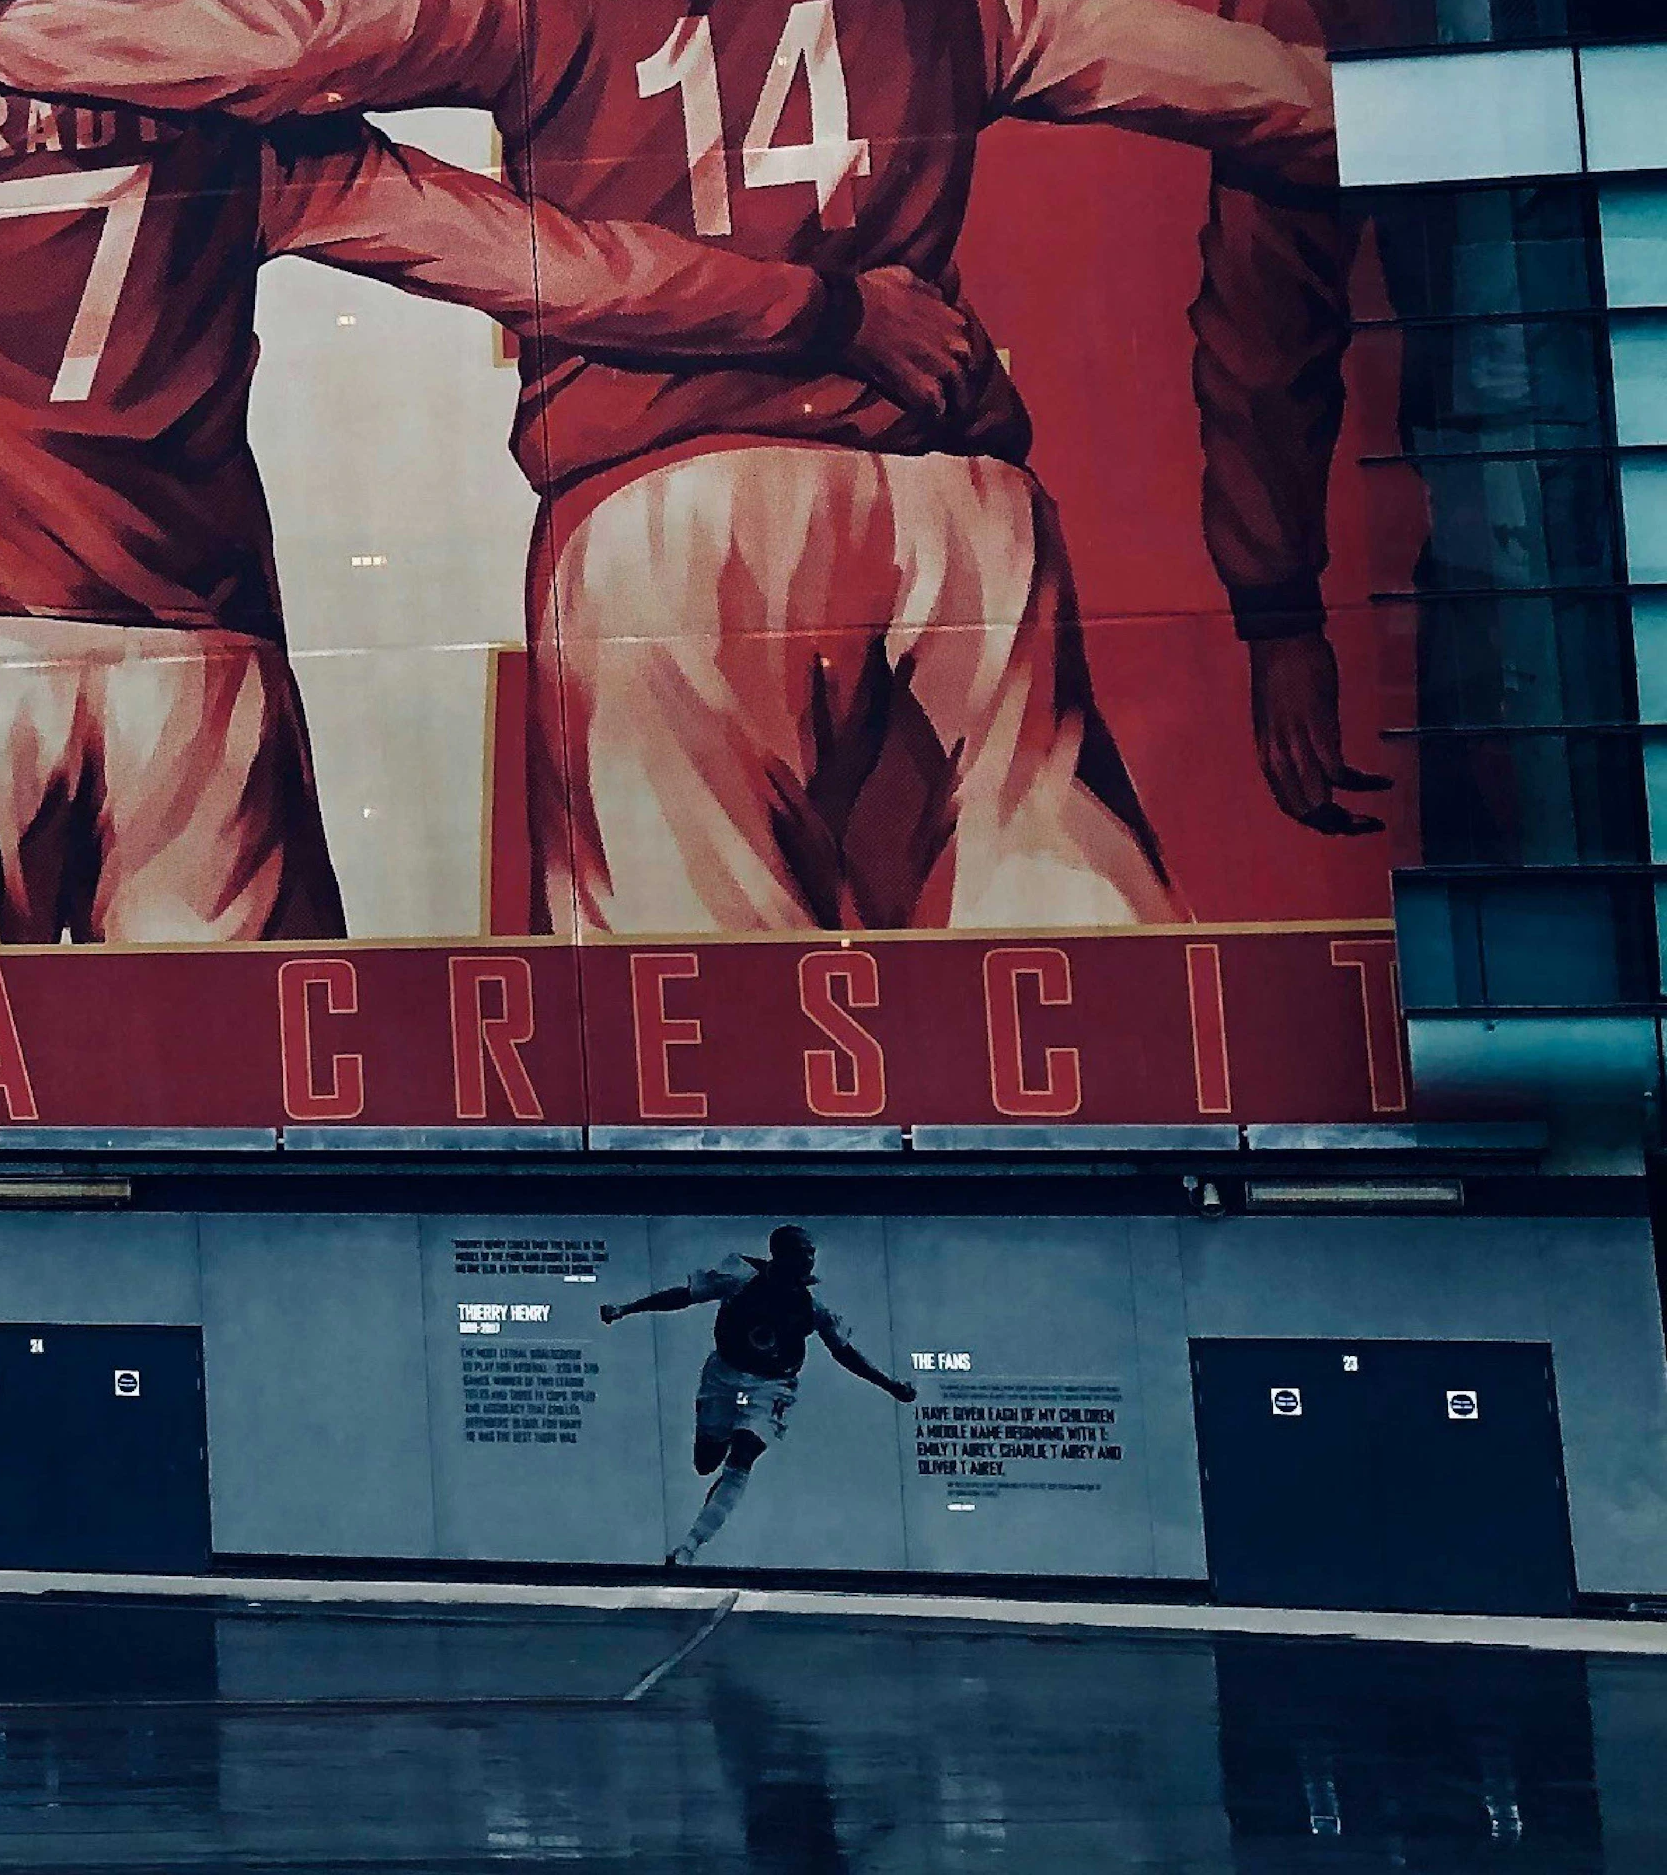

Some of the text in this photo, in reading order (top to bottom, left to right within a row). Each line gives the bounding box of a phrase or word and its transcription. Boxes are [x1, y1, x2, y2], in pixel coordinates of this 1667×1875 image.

[277, 939, 1408, 1123] CRESCIT
[457, 1304, 551, 1322] THIERRY HENRY
[911, 1353, 971, 1370] THE FANS
